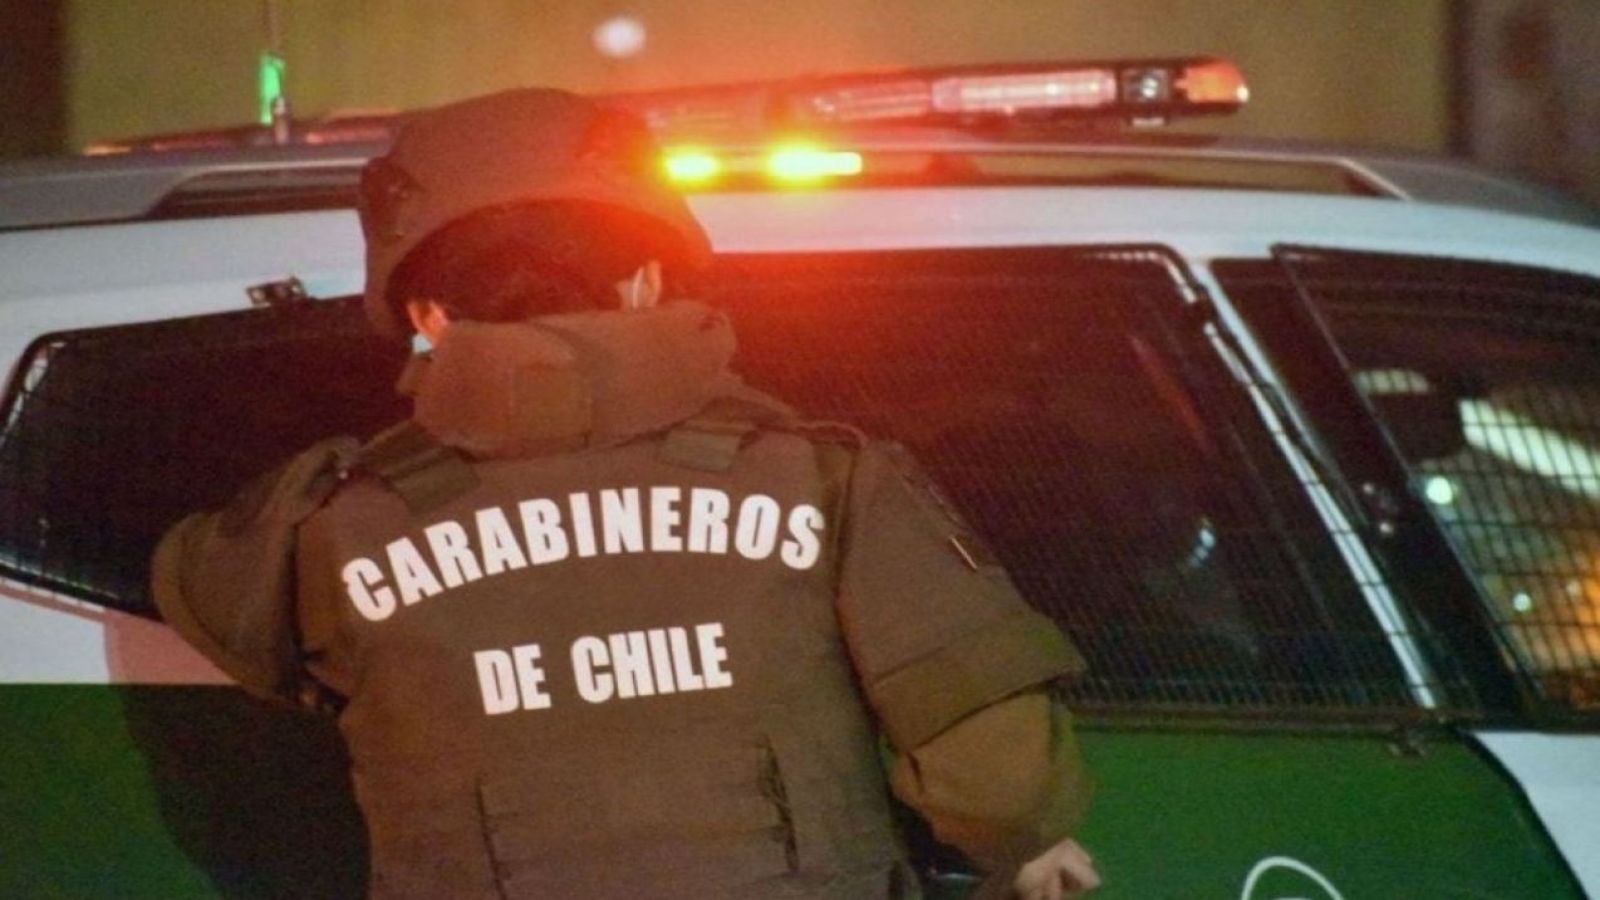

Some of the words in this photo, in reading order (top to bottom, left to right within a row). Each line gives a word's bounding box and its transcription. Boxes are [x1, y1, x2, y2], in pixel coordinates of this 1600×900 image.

[341, 486, 825, 622] CARABINEROS
[473, 644, 552, 716] DE
[570, 622, 734, 704] CHILE
